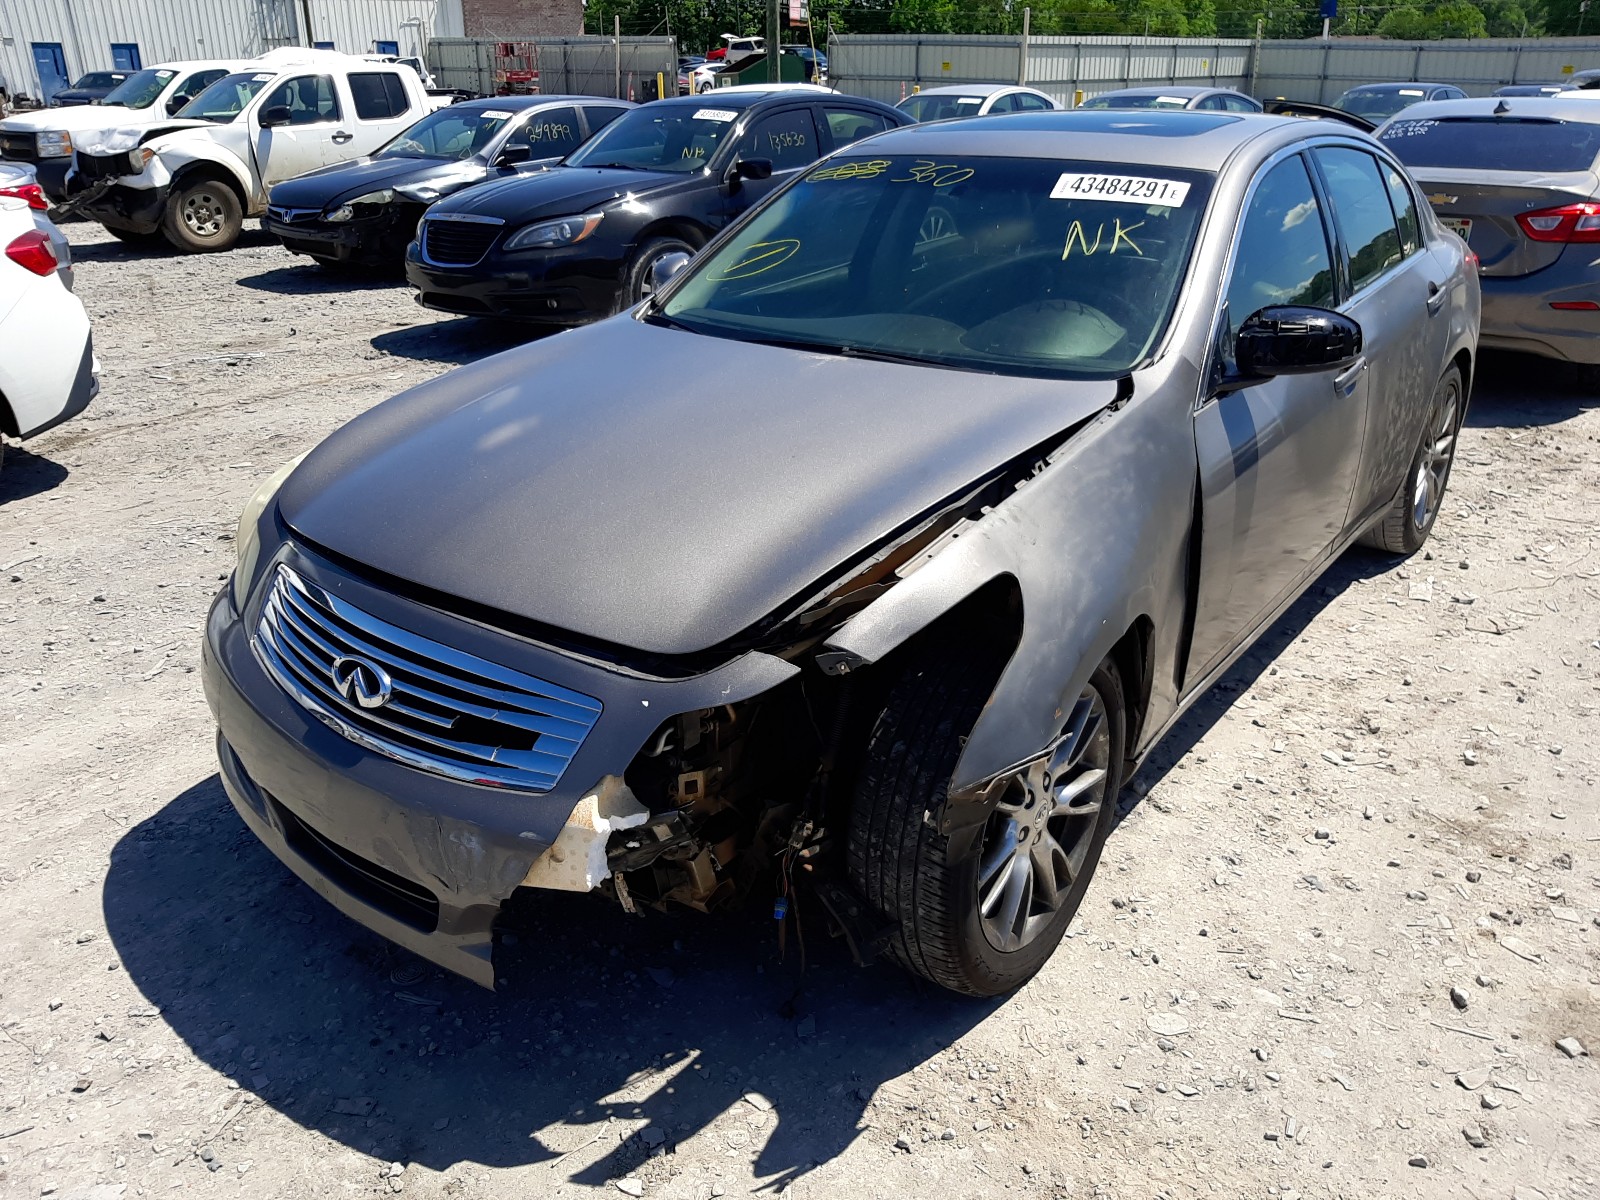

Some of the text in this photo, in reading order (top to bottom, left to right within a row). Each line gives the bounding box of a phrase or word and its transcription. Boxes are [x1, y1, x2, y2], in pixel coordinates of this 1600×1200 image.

[768, 131, 806, 153] 135630
[891, 160, 975, 187] 360
[1070, 176, 1170, 200] 43484291
[1170, 189, 1179, 200] E
[1061, 218, 1145, 260] NK
